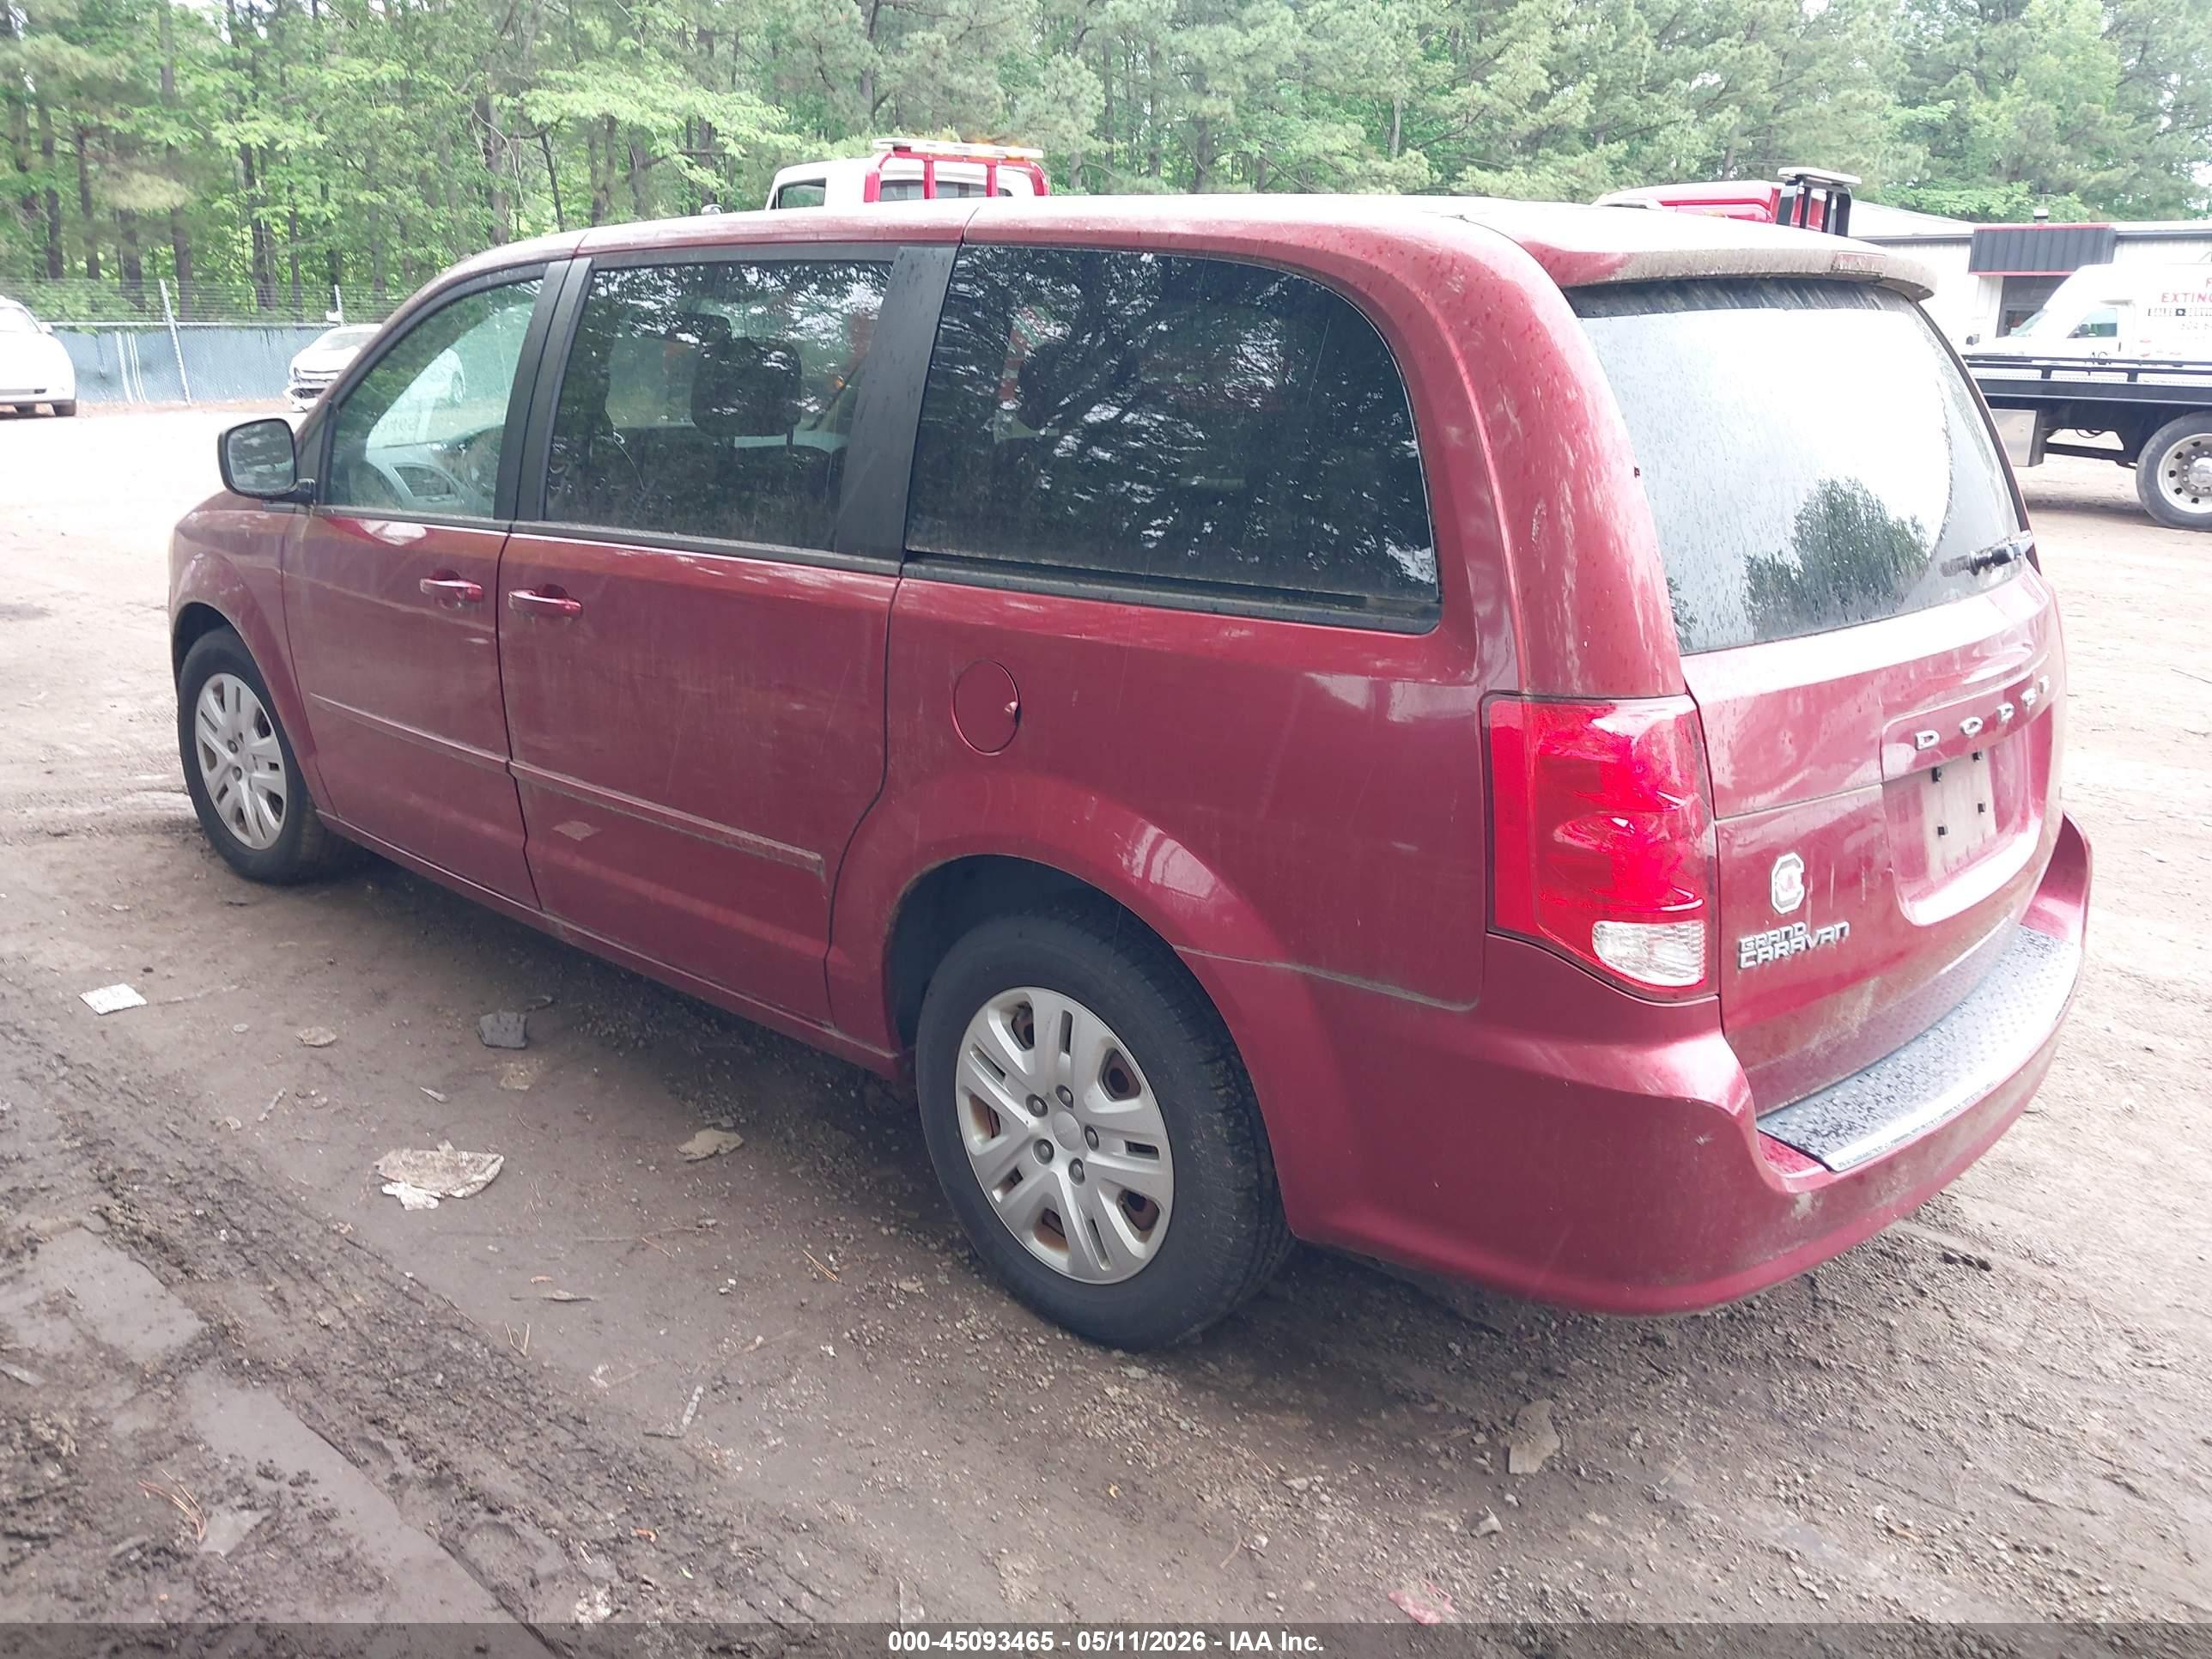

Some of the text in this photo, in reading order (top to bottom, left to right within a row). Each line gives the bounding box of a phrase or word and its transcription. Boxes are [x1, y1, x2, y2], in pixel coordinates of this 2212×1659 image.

[1915, 675, 2051, 751] DODGE
[1738, 921, 1850, 969] CARAVAN
[1739, 921, 1808, 952] GRAND
